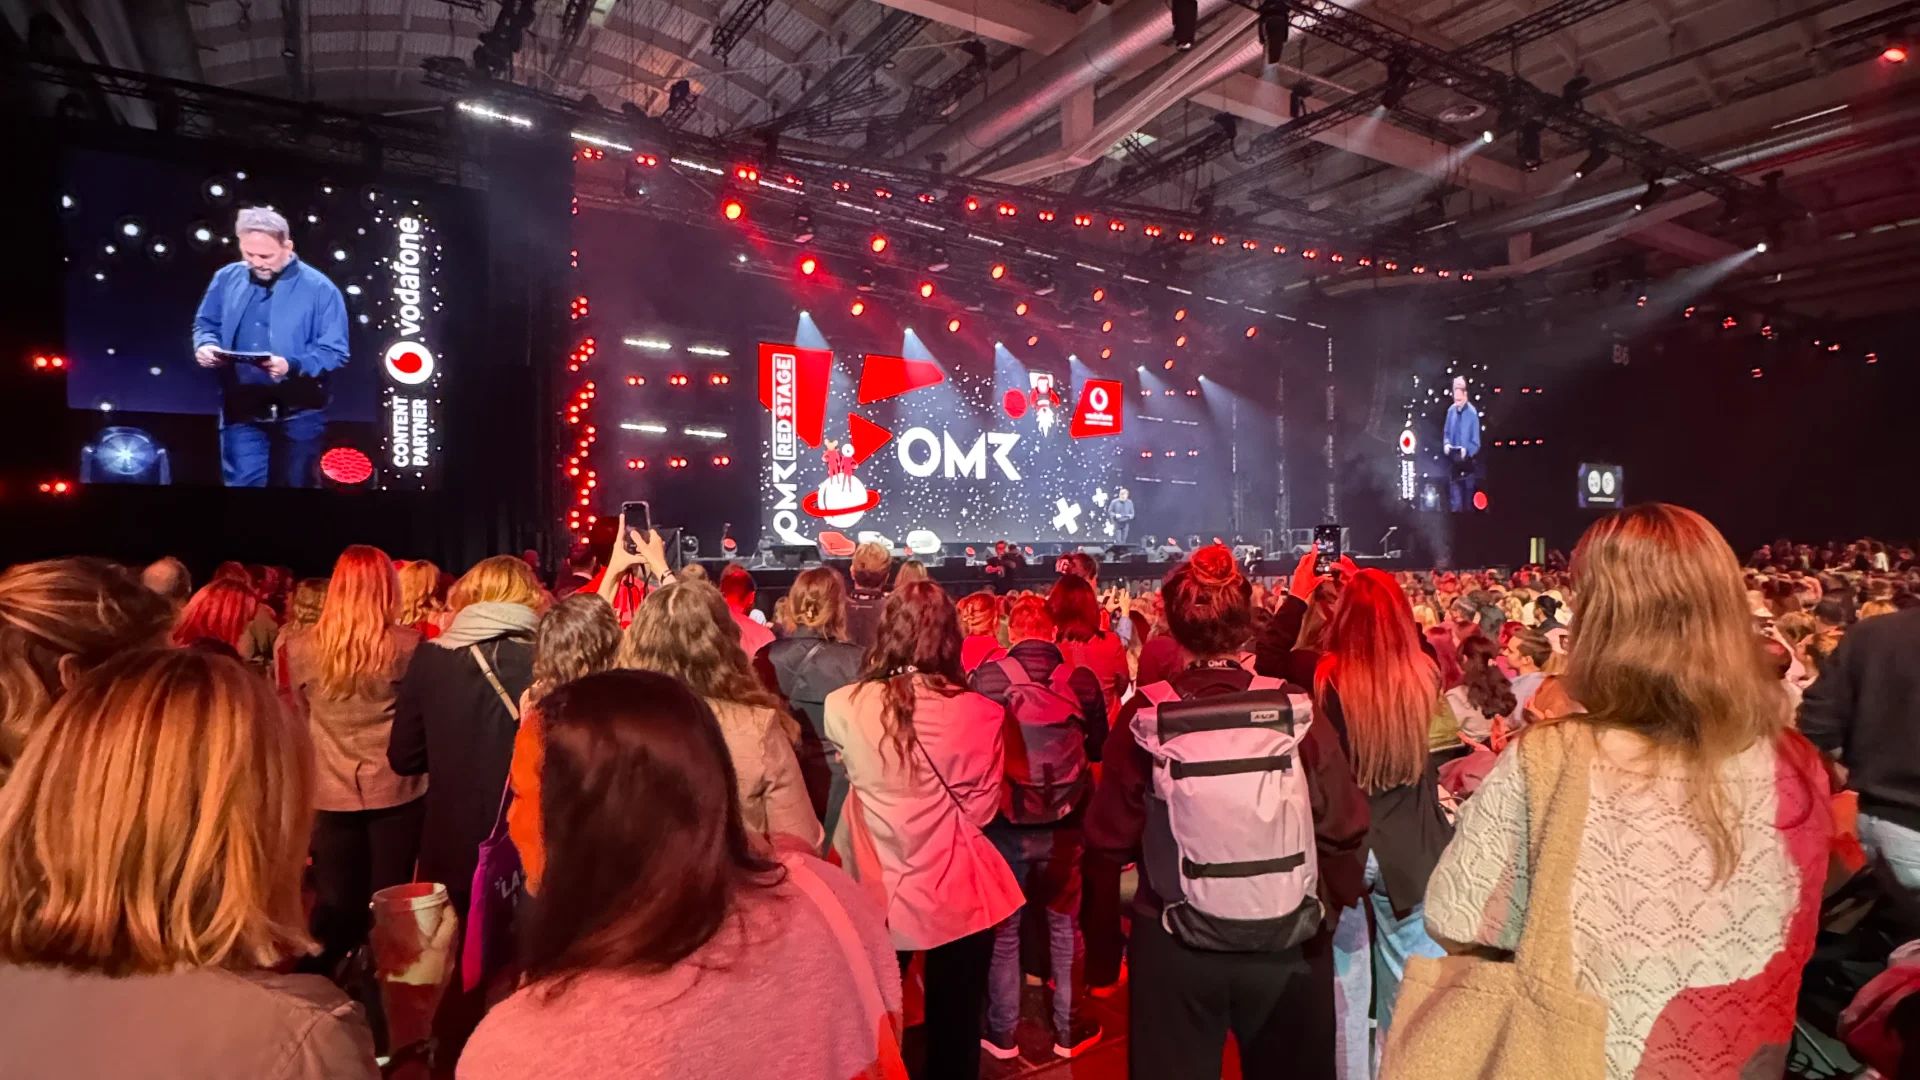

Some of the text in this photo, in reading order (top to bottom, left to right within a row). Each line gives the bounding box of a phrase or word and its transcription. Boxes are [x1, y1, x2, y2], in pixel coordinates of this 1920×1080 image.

[394, 217, 420, 336] vodafone
[392, 396, 409, 468] CONTENT
[412, 399, 428, 466] PARTNER
[776, 358, 793, 457] RED STAGE
[897, 427, 1022, 481] OMR
